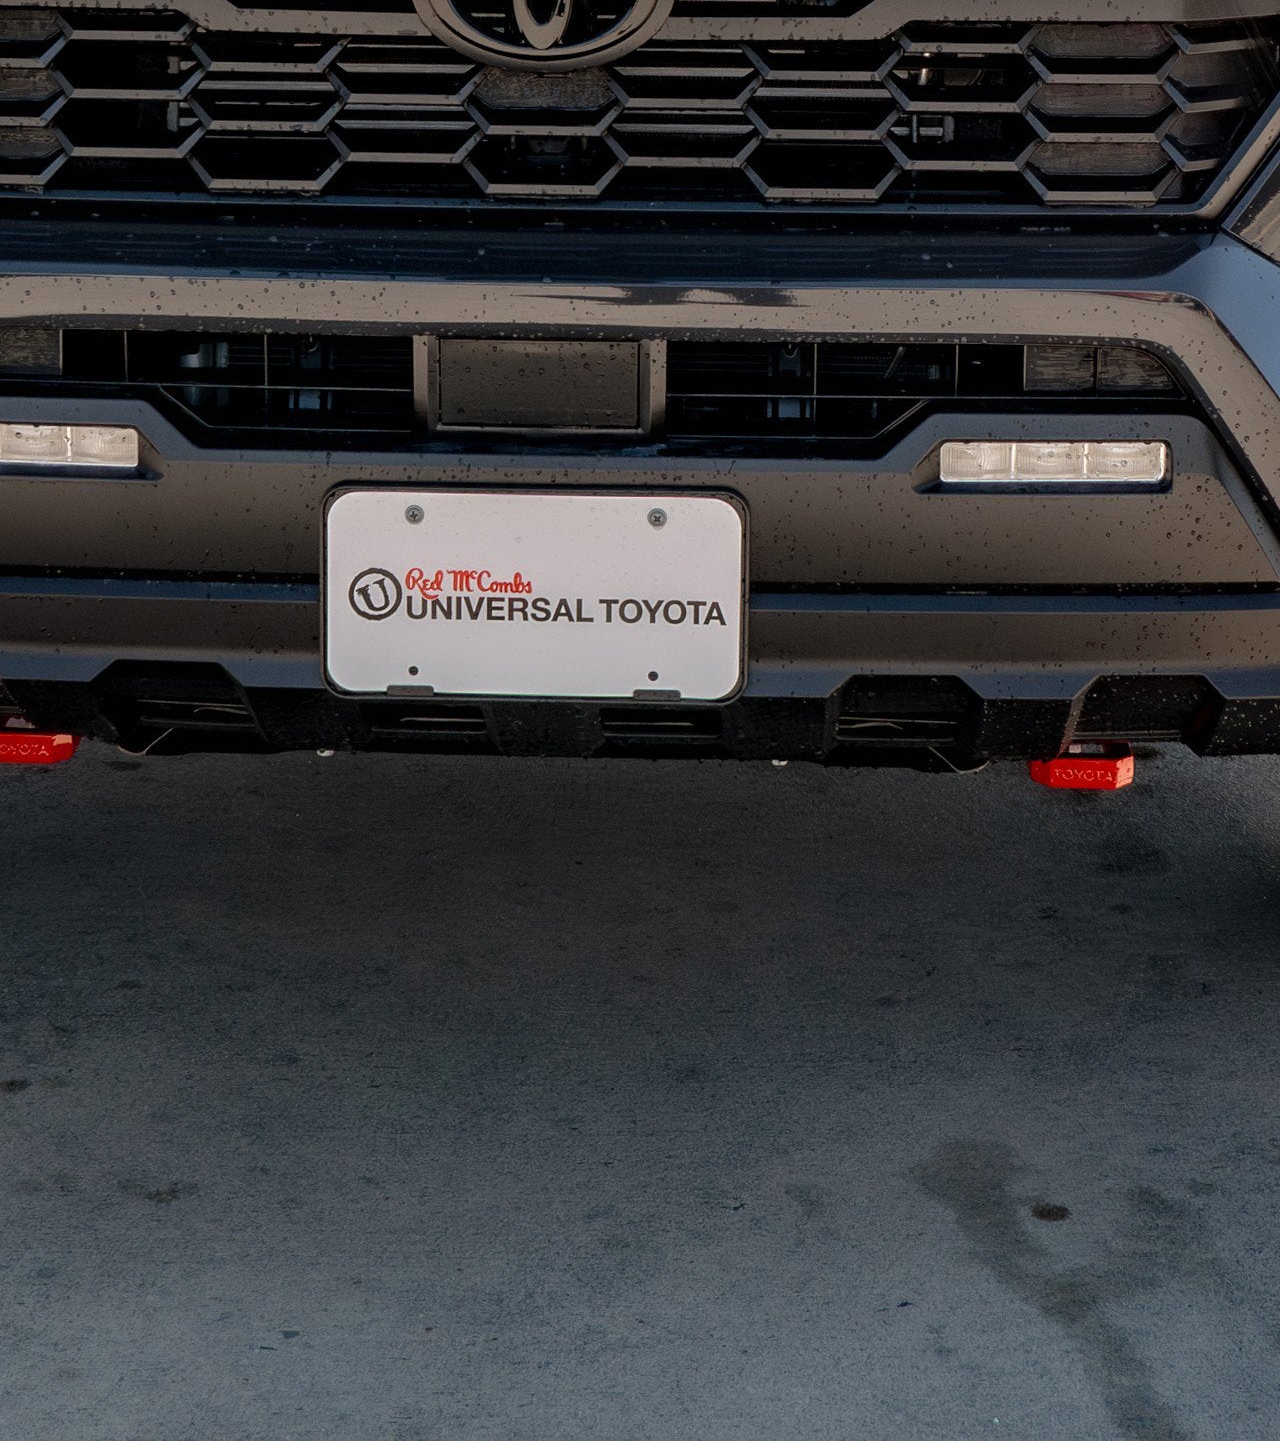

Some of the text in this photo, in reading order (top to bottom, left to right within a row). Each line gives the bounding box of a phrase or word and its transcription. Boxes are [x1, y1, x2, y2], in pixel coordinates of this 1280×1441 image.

[405, 567, 533, 599] Red McCombs
[406, 595, 727, 625] UNIVERSAL TOYOTA
[1054, 768, 1114, 781] TOYOTA
